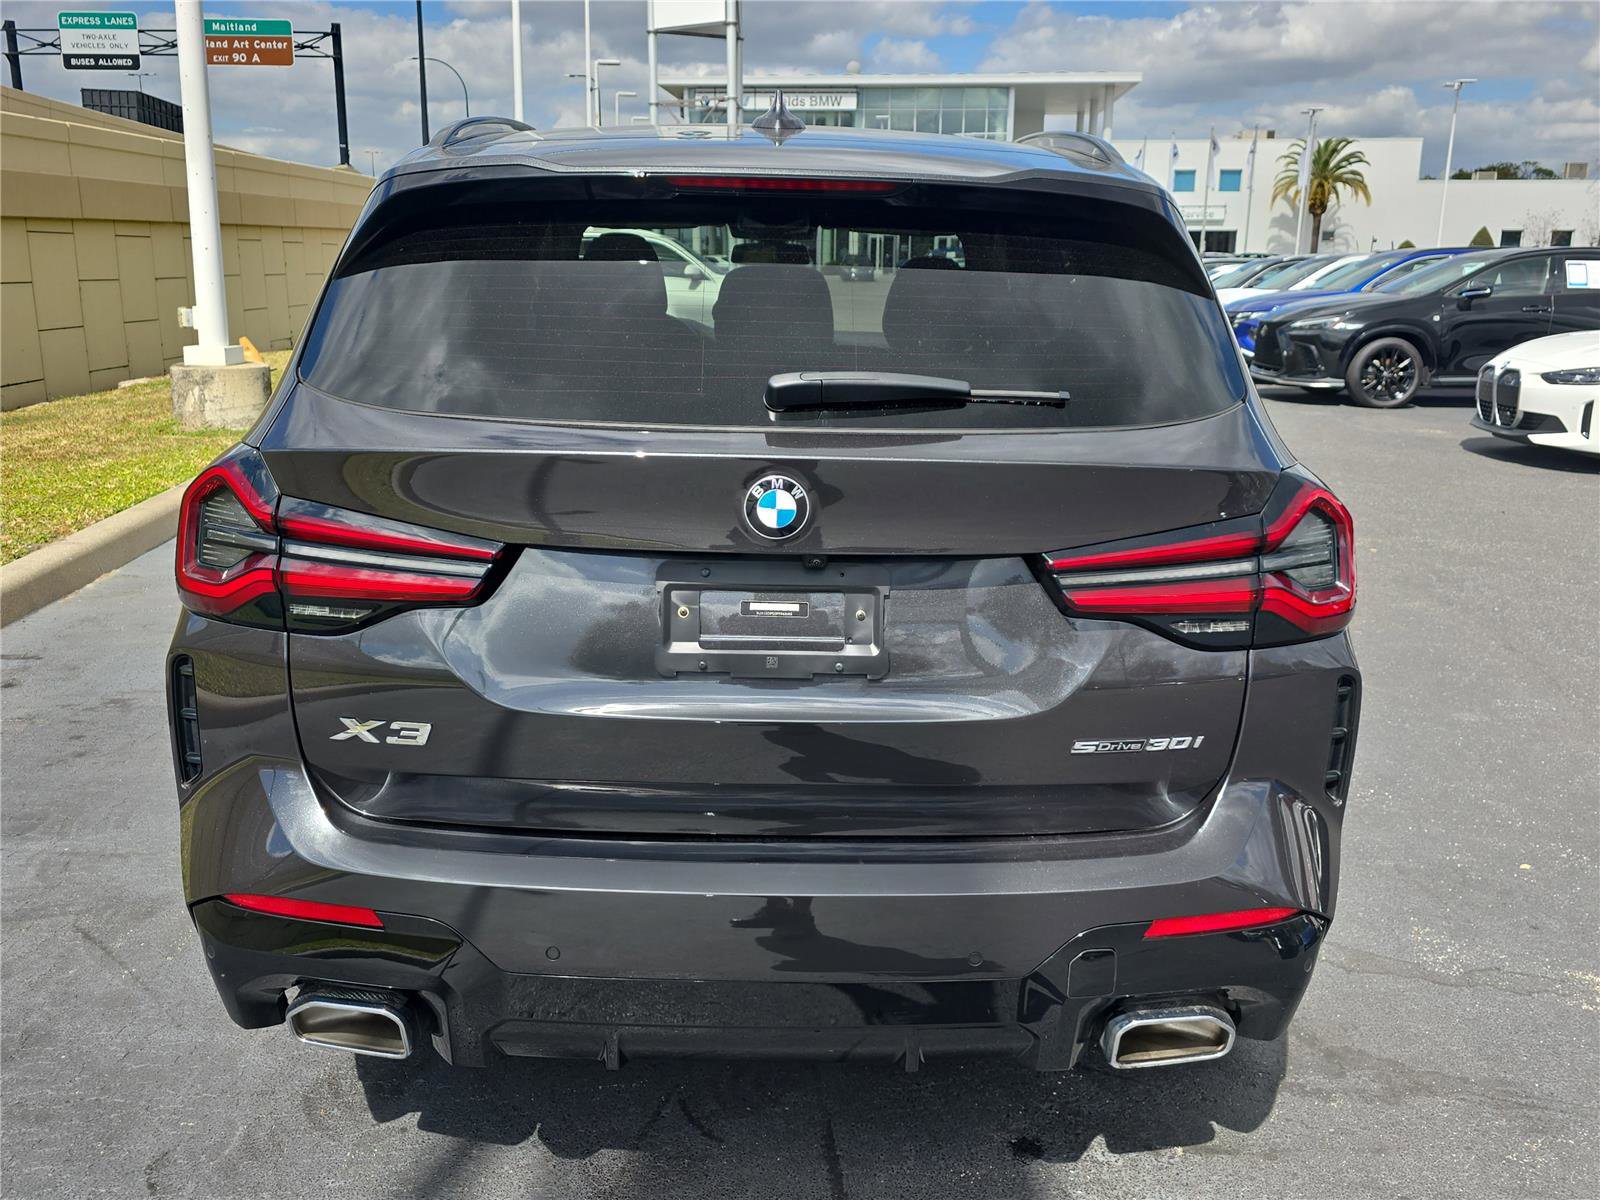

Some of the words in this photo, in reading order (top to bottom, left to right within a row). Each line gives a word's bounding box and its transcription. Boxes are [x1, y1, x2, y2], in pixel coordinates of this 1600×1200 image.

[61, 16, 101, 25] EXPRESS
[104, 17, 134, 26] LANES
[212, 22, 257, 31] Maitland
[206, 40, 228, 48] land
[233, 40, 249, 48] Art
[254, 40, 287, 49] Center
[70, 58, 95, 66] BUSES
[98, 58, 133, 66] ALLOWED
[232, 53, 247, 62] 90
[252, 53, 261, 62] A
[769, 95, 806, 107] Flds
[810, 95, 843, 107] BMW
[752, 478, 804, 499] BMW
[329, 717, 432, 746] X3
